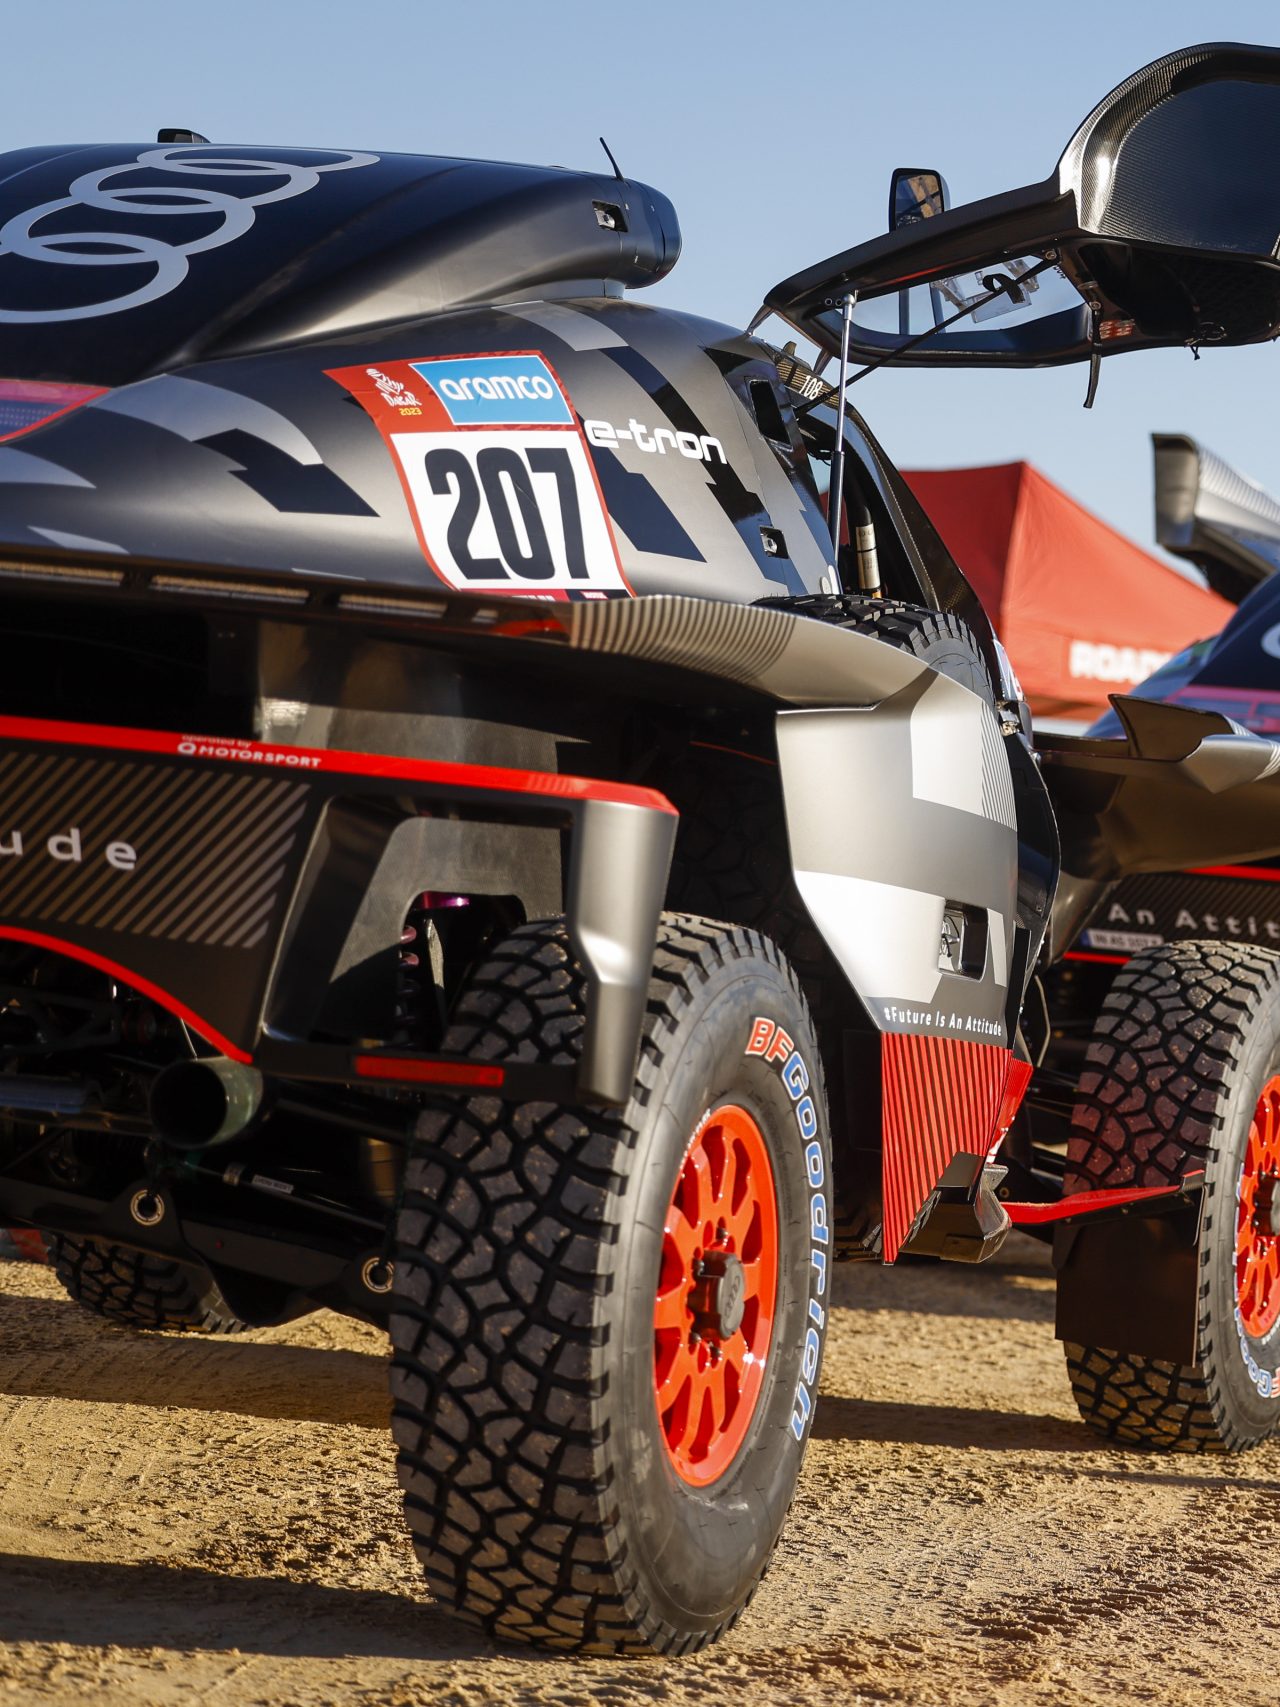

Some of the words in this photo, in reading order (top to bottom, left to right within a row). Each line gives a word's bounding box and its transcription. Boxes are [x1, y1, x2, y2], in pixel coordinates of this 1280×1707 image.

[439, 375, 553, 401] aramco
[799, 375, 823, 400] 108
[399, 407, 423, 416] 2023
[584, 418, 728, 465] e-tron
[424, 447, 590, 580] 207
[198, 745, 322, 768] MOTORSPORT
[1108, 903, 1155, 925] An
[883, 1006, 932, 1026] #Future
[935, 1010, 946, 1028] Is
[948, 1012, 962, 1030] An
[965, 1015, 1002, 1037] Attitude
[745, 1016, 829, 1441] BFGoodrich
